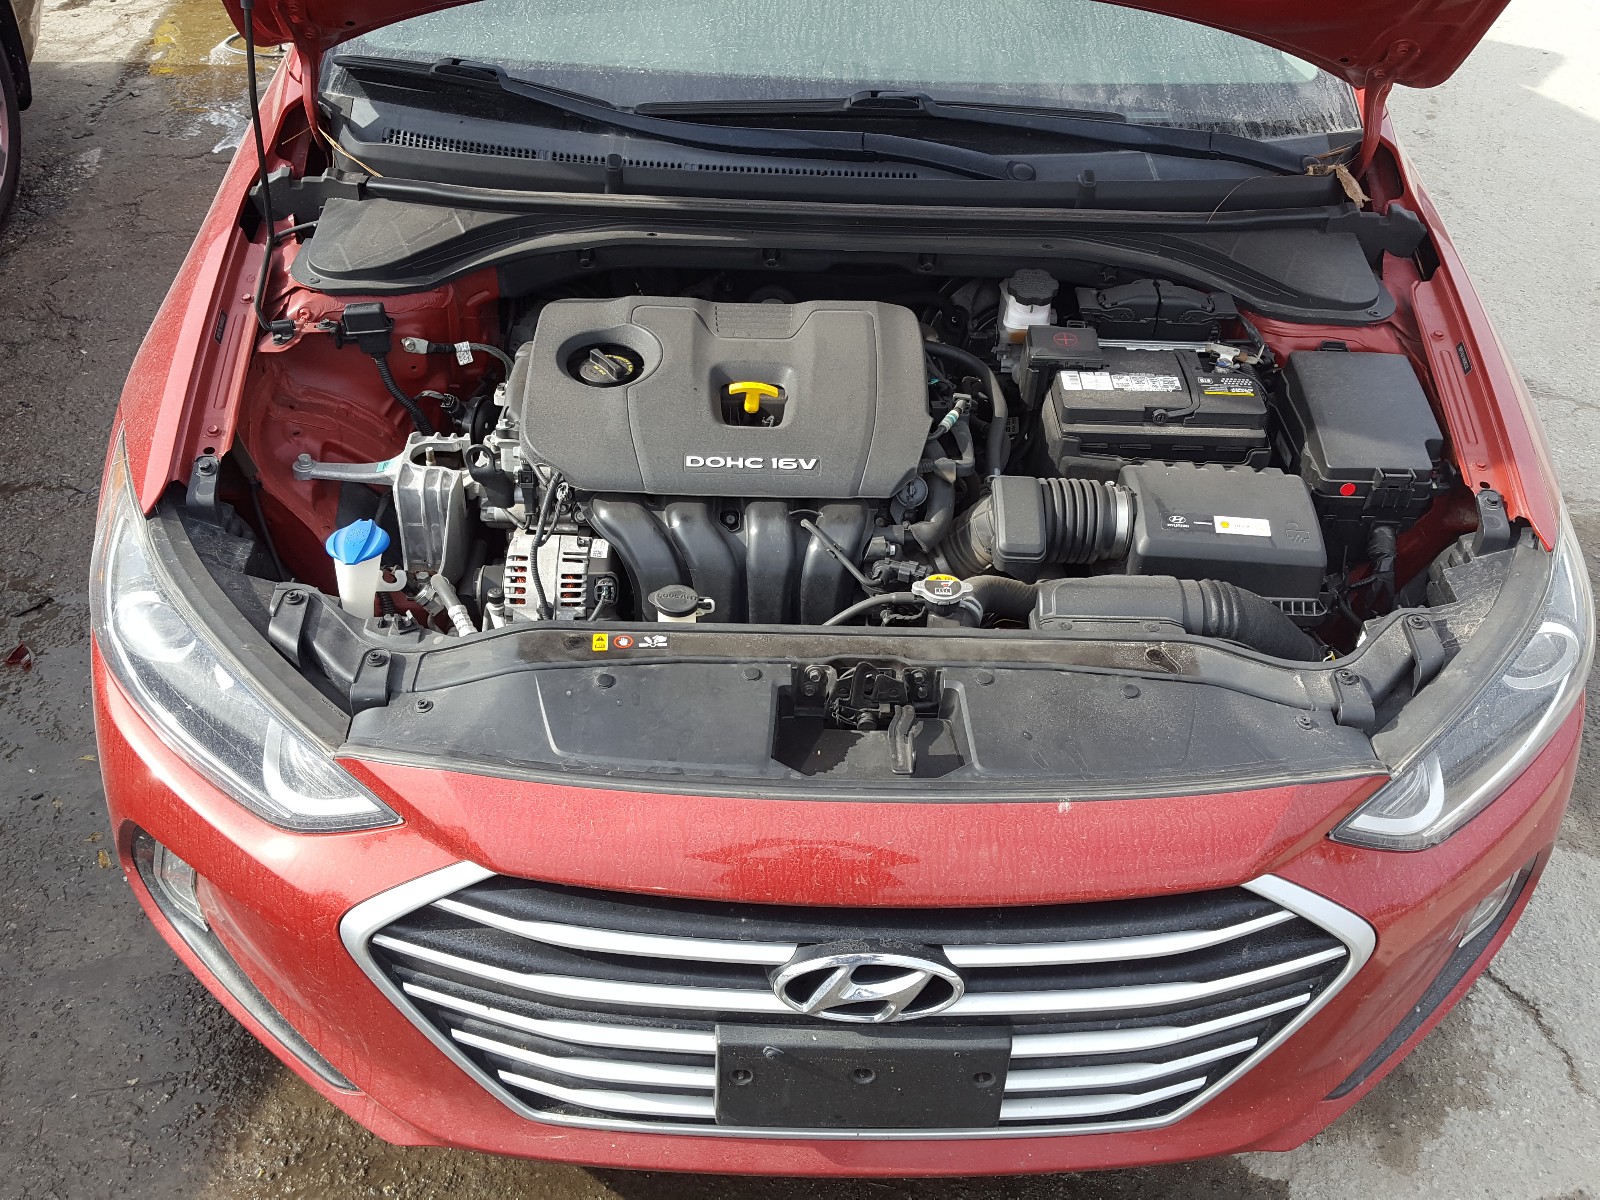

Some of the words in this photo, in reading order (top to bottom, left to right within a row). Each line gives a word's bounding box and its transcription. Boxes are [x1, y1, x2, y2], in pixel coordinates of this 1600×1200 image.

[685, 455, 764, 469] DOHC
[771, 457, 817, 470] 16V
[657, 593, 698, 601] COOLANT
